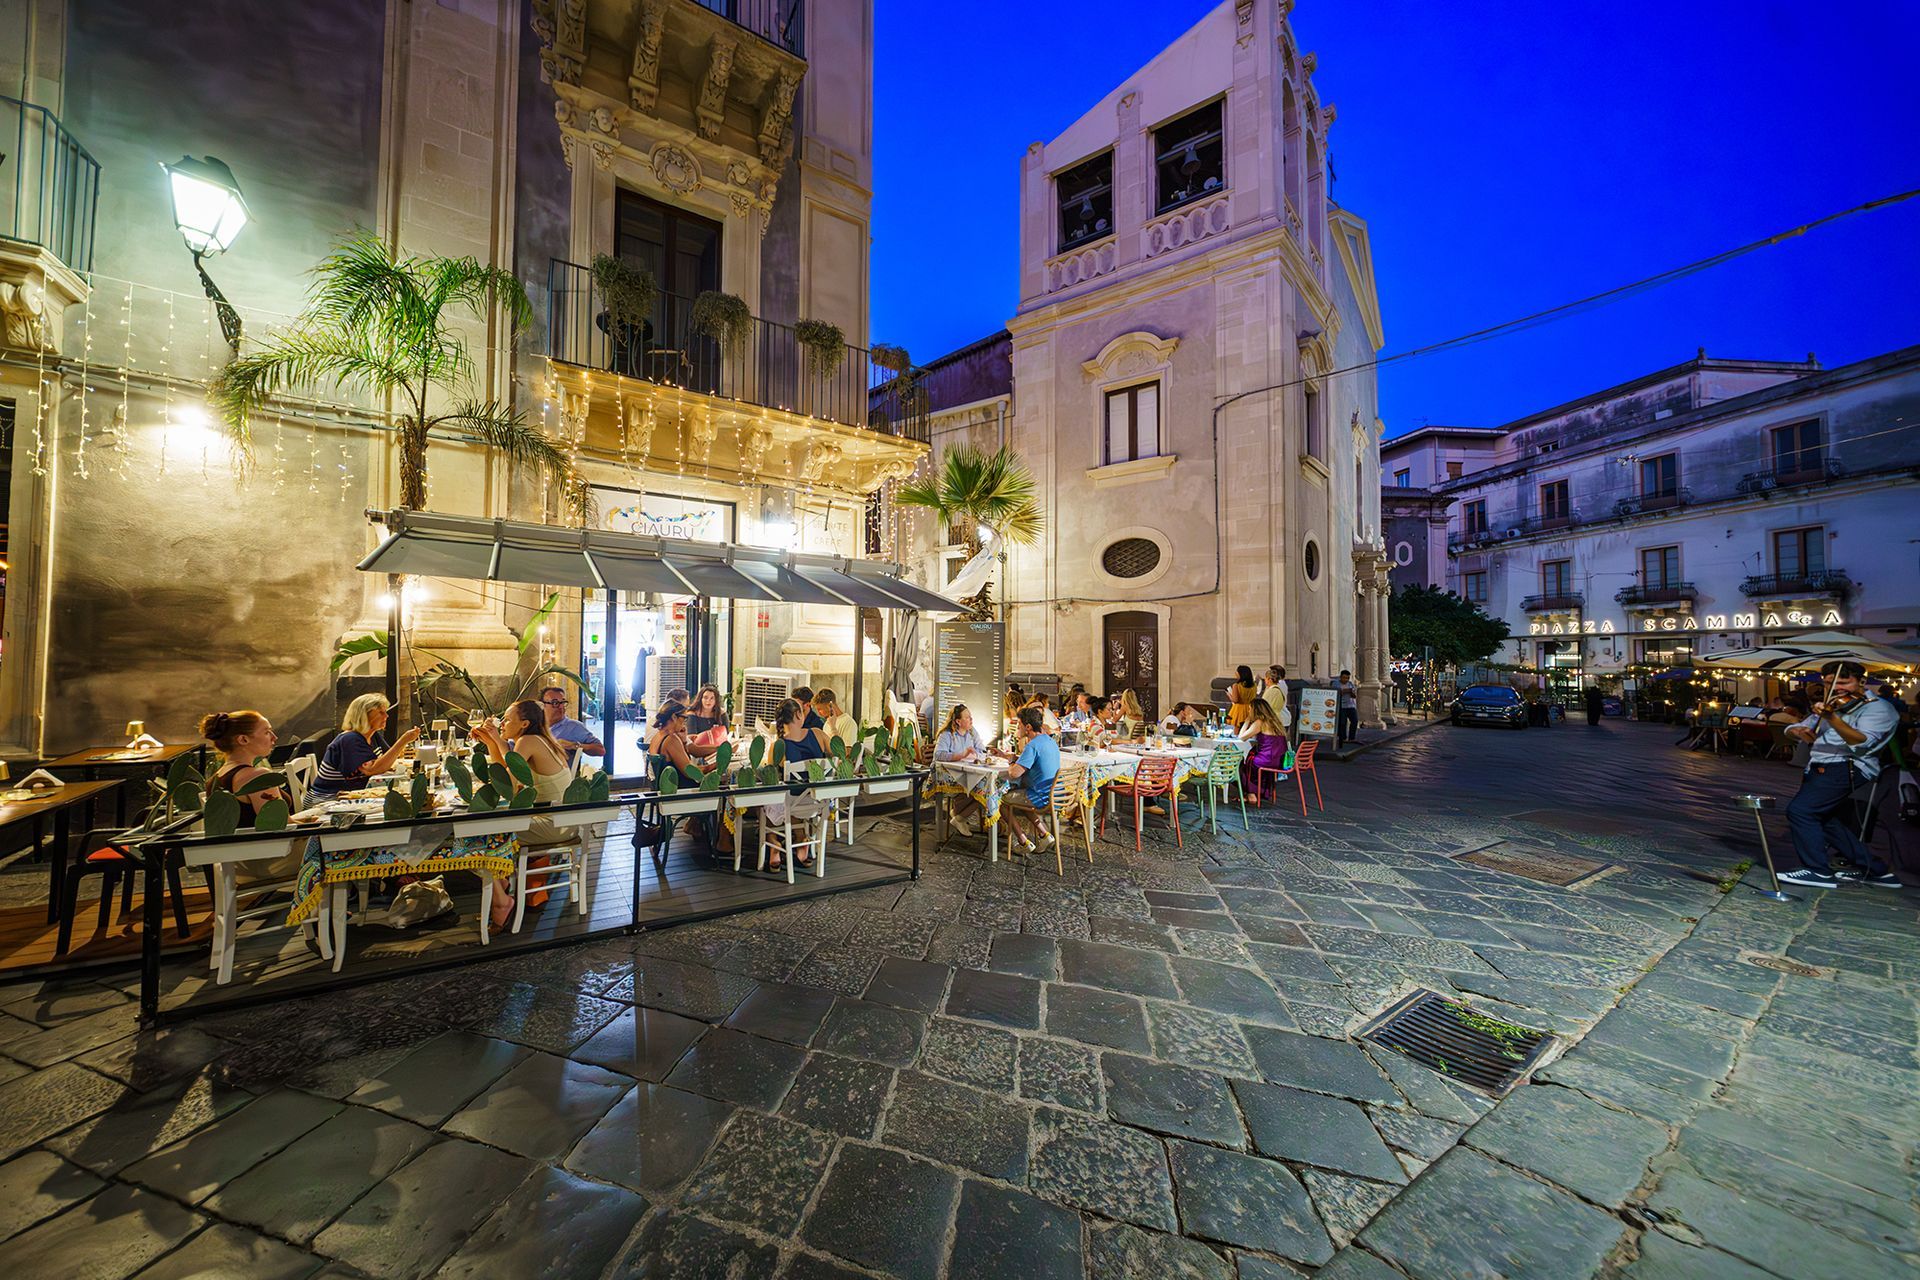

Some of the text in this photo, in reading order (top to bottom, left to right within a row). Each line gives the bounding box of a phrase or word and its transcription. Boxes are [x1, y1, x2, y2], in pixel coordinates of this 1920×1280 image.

[631, 521, 694, 539] CIAURU
[1530, 609, 1841, 635] PIAZZA SCAMMACCA
